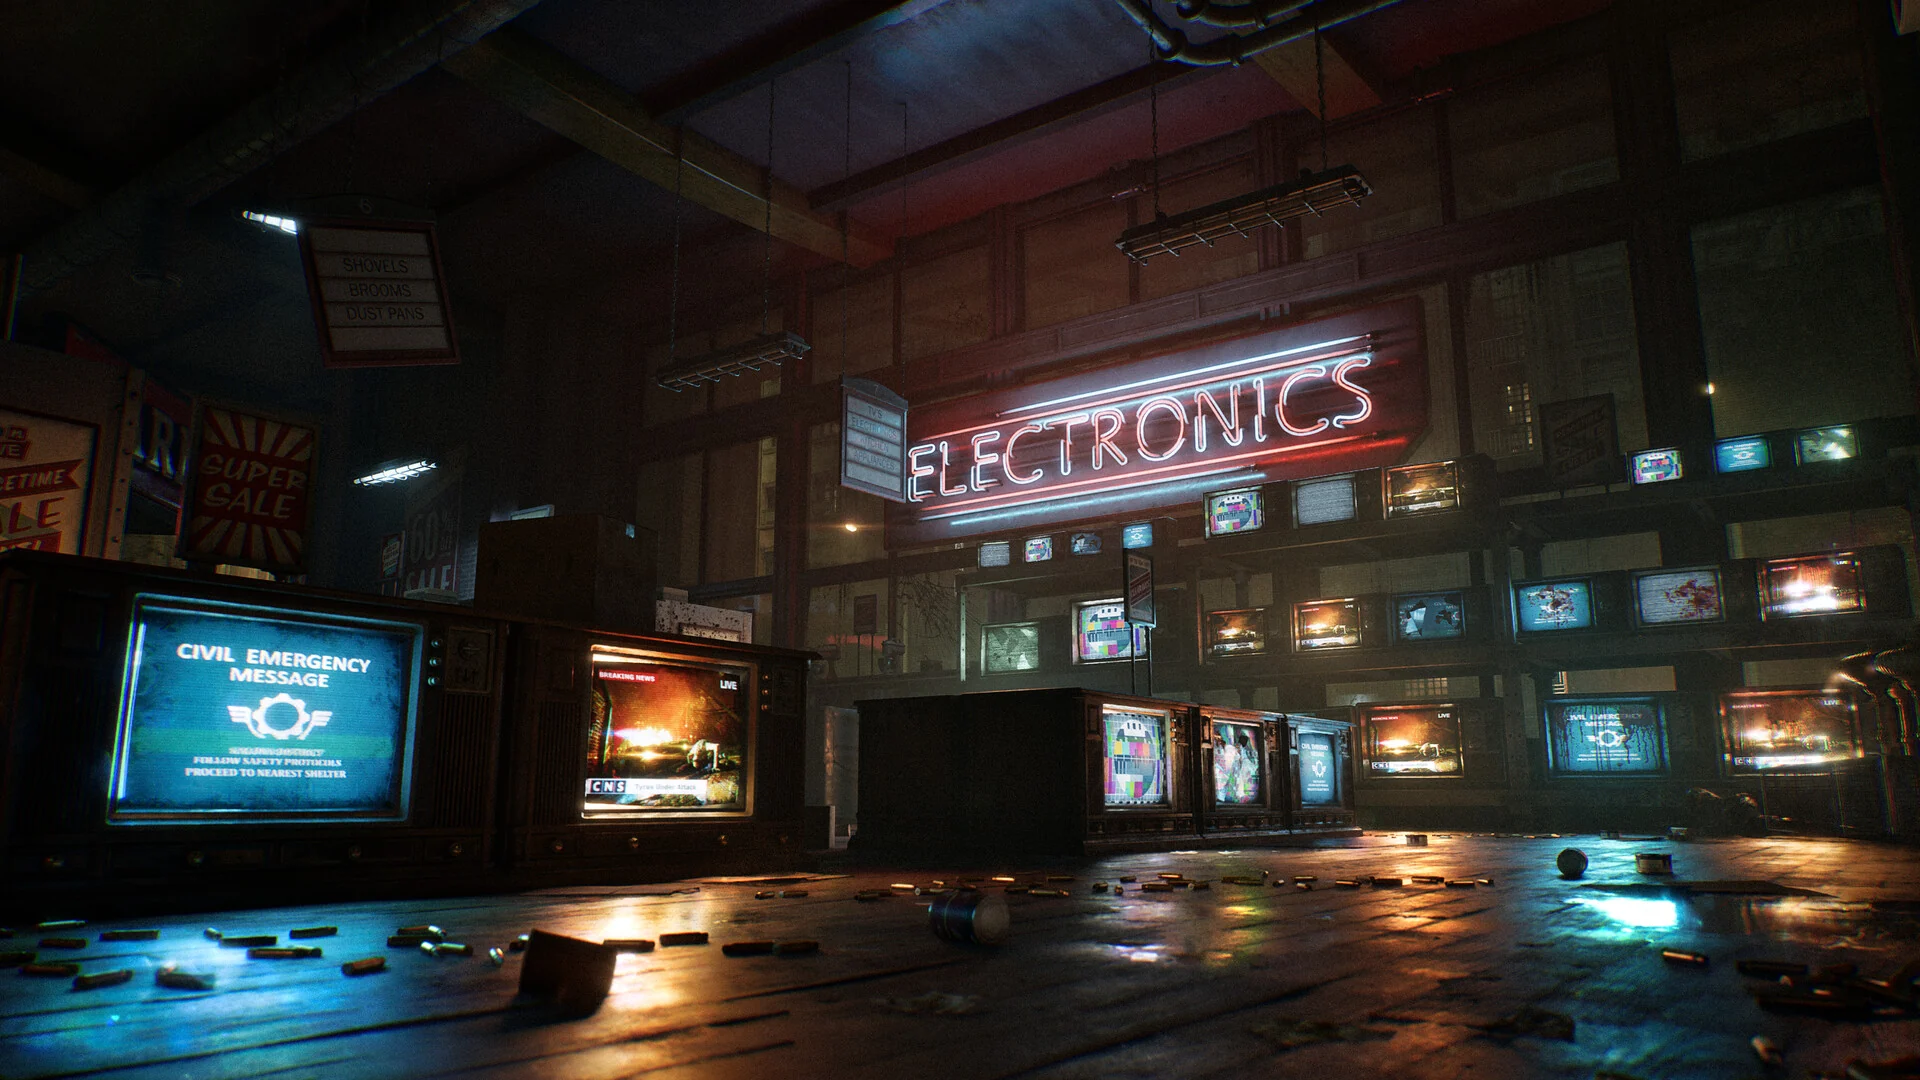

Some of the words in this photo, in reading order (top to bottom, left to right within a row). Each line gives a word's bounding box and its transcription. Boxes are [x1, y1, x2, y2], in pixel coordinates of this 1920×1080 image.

[343, 257, 409, 273] SHOVELS
[349, 283, 412, 298] BROOMS
[346, 306, 383, 321] DUST
[388, 306, 425, 321] PANS
[907, 355, 1373, 503] ELECTRONICS
[201, 453, 308, 491] SUPER
[203, 482, 297, 520] SALE
[176, 643, 236, 662] CIVIL
[246, 648, 371, 673] EMERGENCY
[229, 667, 330, 688] MESSAGE
[598, 671, 635, 681] BREAKING
[635, 674, 656, 682] NEWS
[719, 679, 739, 691] LIVE
[193, 756, 241, 765] FOLLOW
[242, 757, 283, 766] SAFETY
[184, 768, 238, 777] PROCEED
[239, 768, 255, 777] TO
[256, 769, 303, 778] NEAREST
[304, 770, 347, 778] SHELTER
[592, 781, 626, 792] CNS
